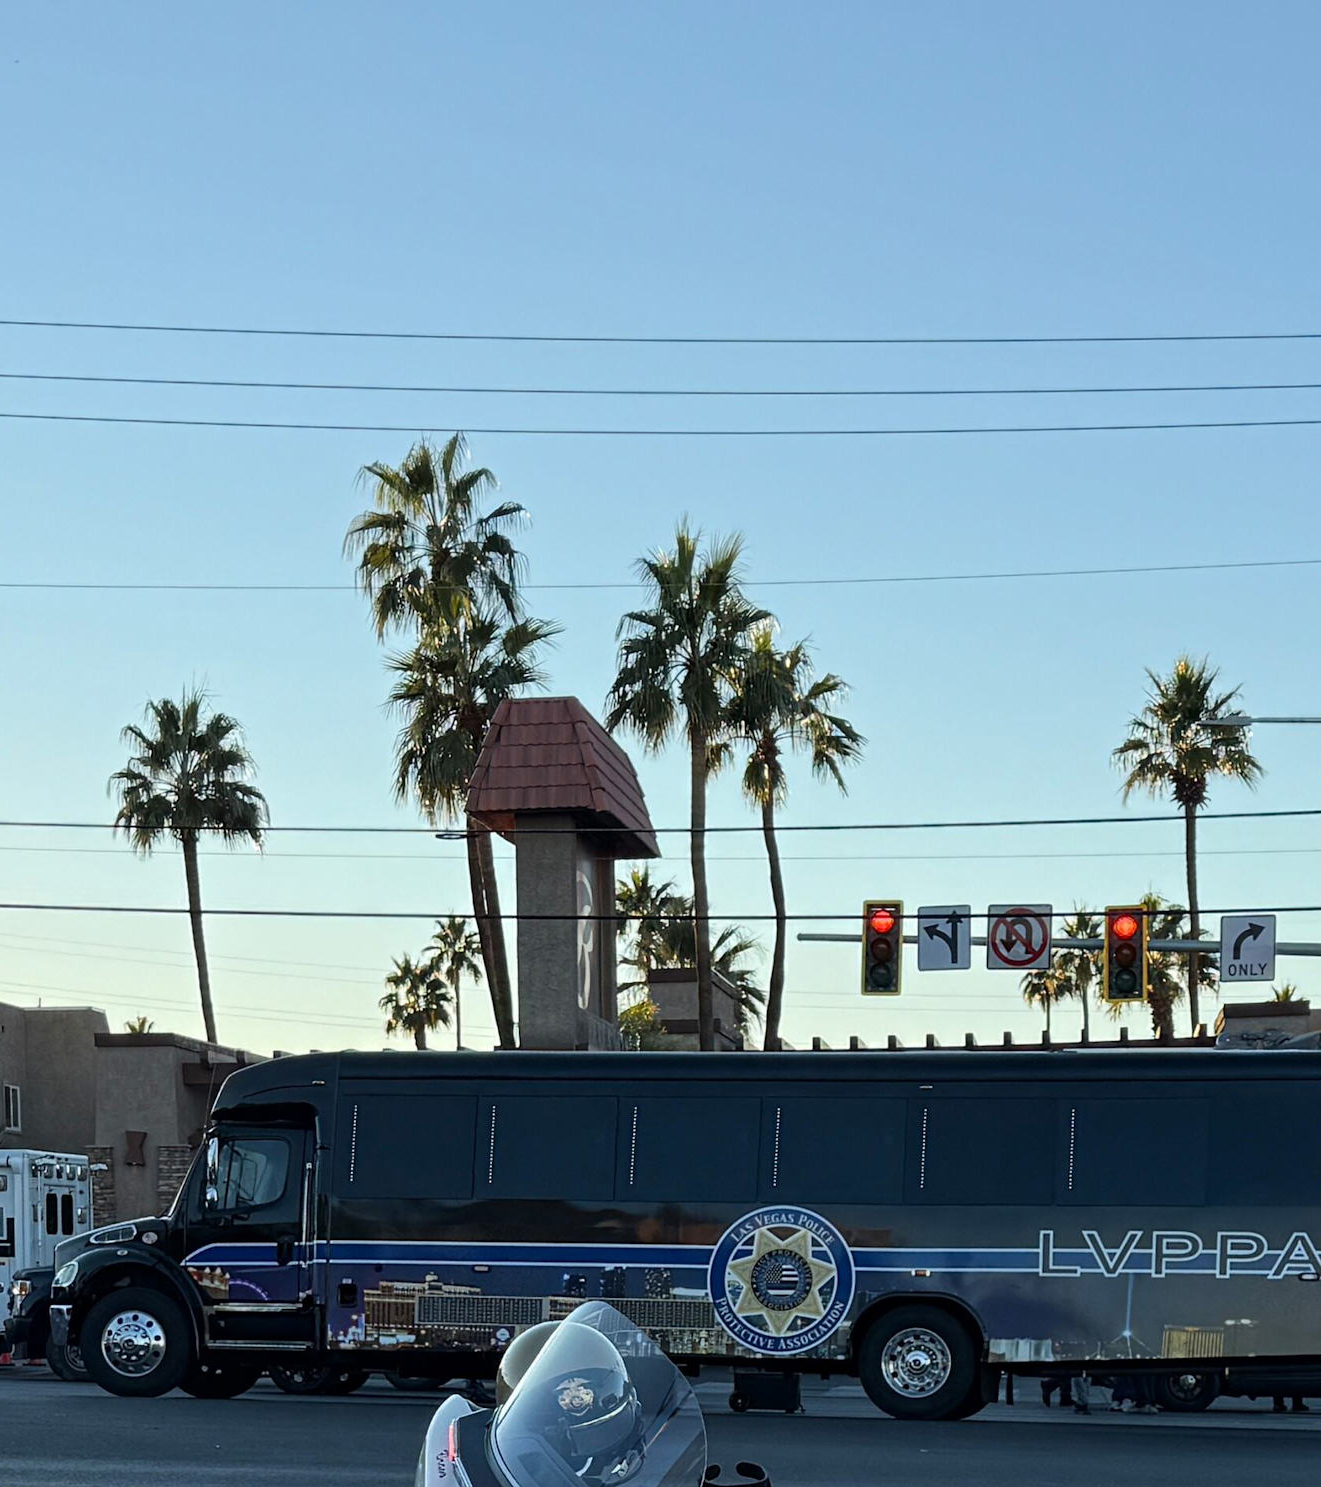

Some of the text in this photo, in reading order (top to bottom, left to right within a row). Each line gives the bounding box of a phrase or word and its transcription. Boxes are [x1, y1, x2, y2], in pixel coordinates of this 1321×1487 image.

[1228, 962, 1268, 977] ONLY
[715, 1297, 846, 1350] PROTECTIVE ASSOCIATION
